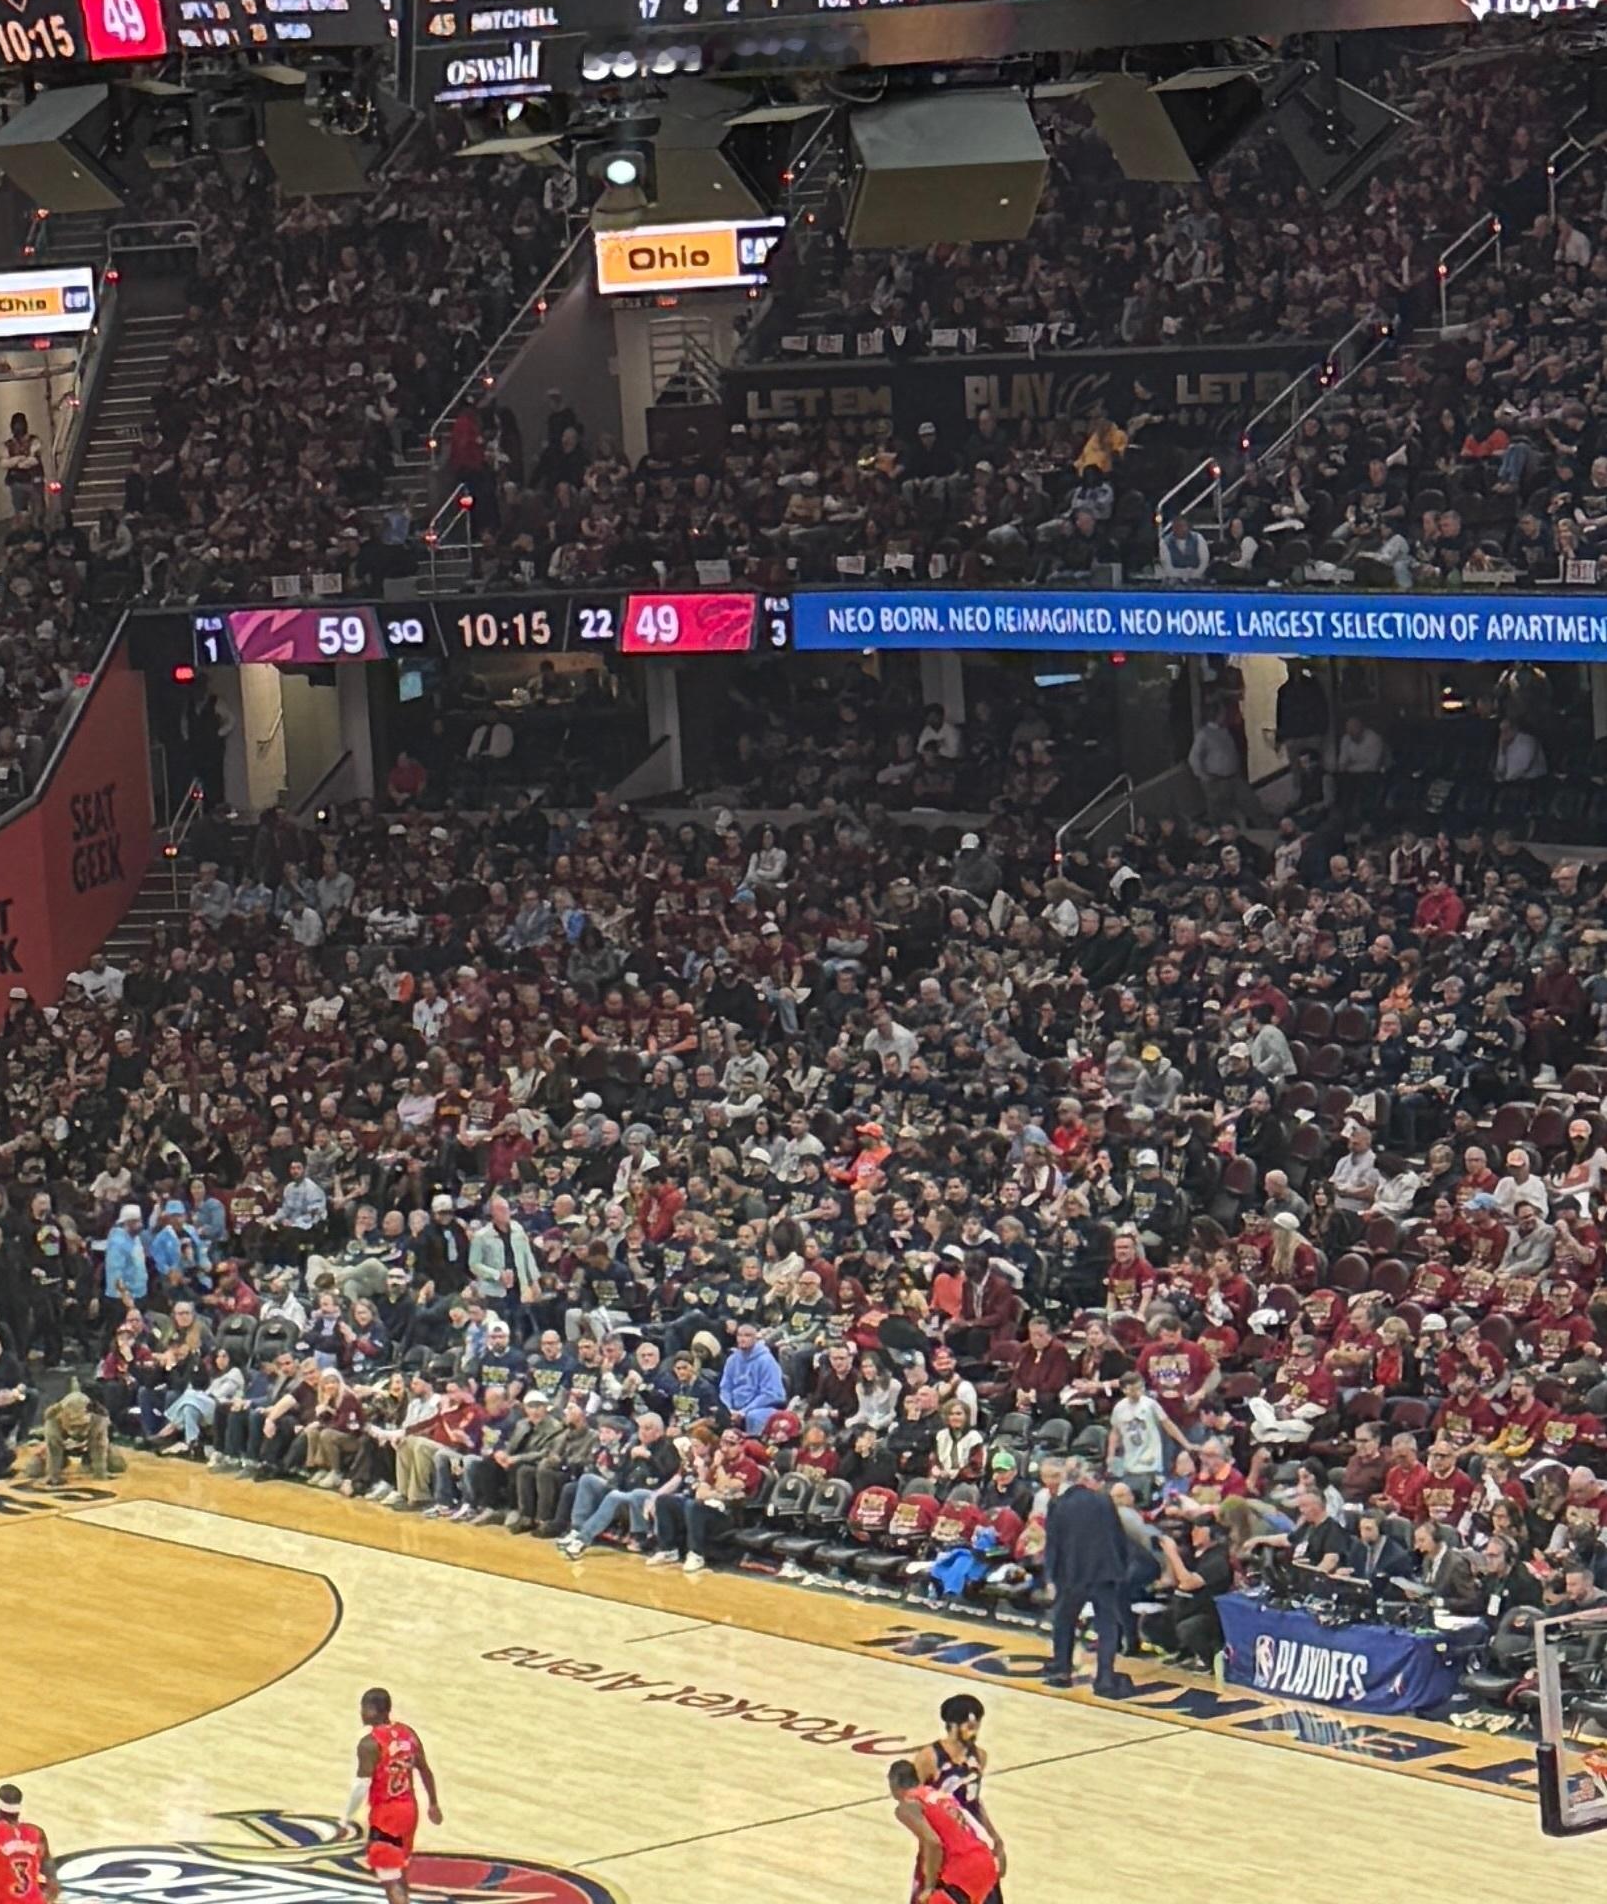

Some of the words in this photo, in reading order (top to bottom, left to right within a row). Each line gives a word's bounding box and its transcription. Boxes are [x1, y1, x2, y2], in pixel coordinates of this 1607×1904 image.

[446, 40, 541, 86] oswald
[629, 246, 709, 270] Ohio
[747, 389, 818, 419] LET
[964, 372, 1054, 420] PLAY
[1176, 373, 1249, 404] LET
[205, 637, 217, 662] 1
[318, 618, 365, 654] 59
[458, 612, 551, 646] 10:15
[580, 610, 613, 638] 22
[636, 606, 678, 643] 49
[771, 620, 786, 646] 3
[828, 607, 874, 633] NEO
[880, 609, 945, 634] BORN.
[949, 609, 990, 633] NEO
[994, 609, 1116, 635] REIMAGINED.
[1119, 609, 1163, 635] NEO
[1166, 611, 1232, 637] HOME.
[1237, 612, 1325, 639] LARGEST
[1331, 613, 1446, 641] SELECTION
[1450, 614, 1479, 641] OF
[1485, 615, 1607, 645] APARTMEN
[70, 782, 117, 841] SEAT
[72, 835, 127, 893] GEEK
[480, 1645, 660, 1696] Arena
[1275, 1639, 1368, 1701] PLAYOFFS
[666, 1684, 858, 1749] Rocket
[9, 1858, 32, 1897] 3
